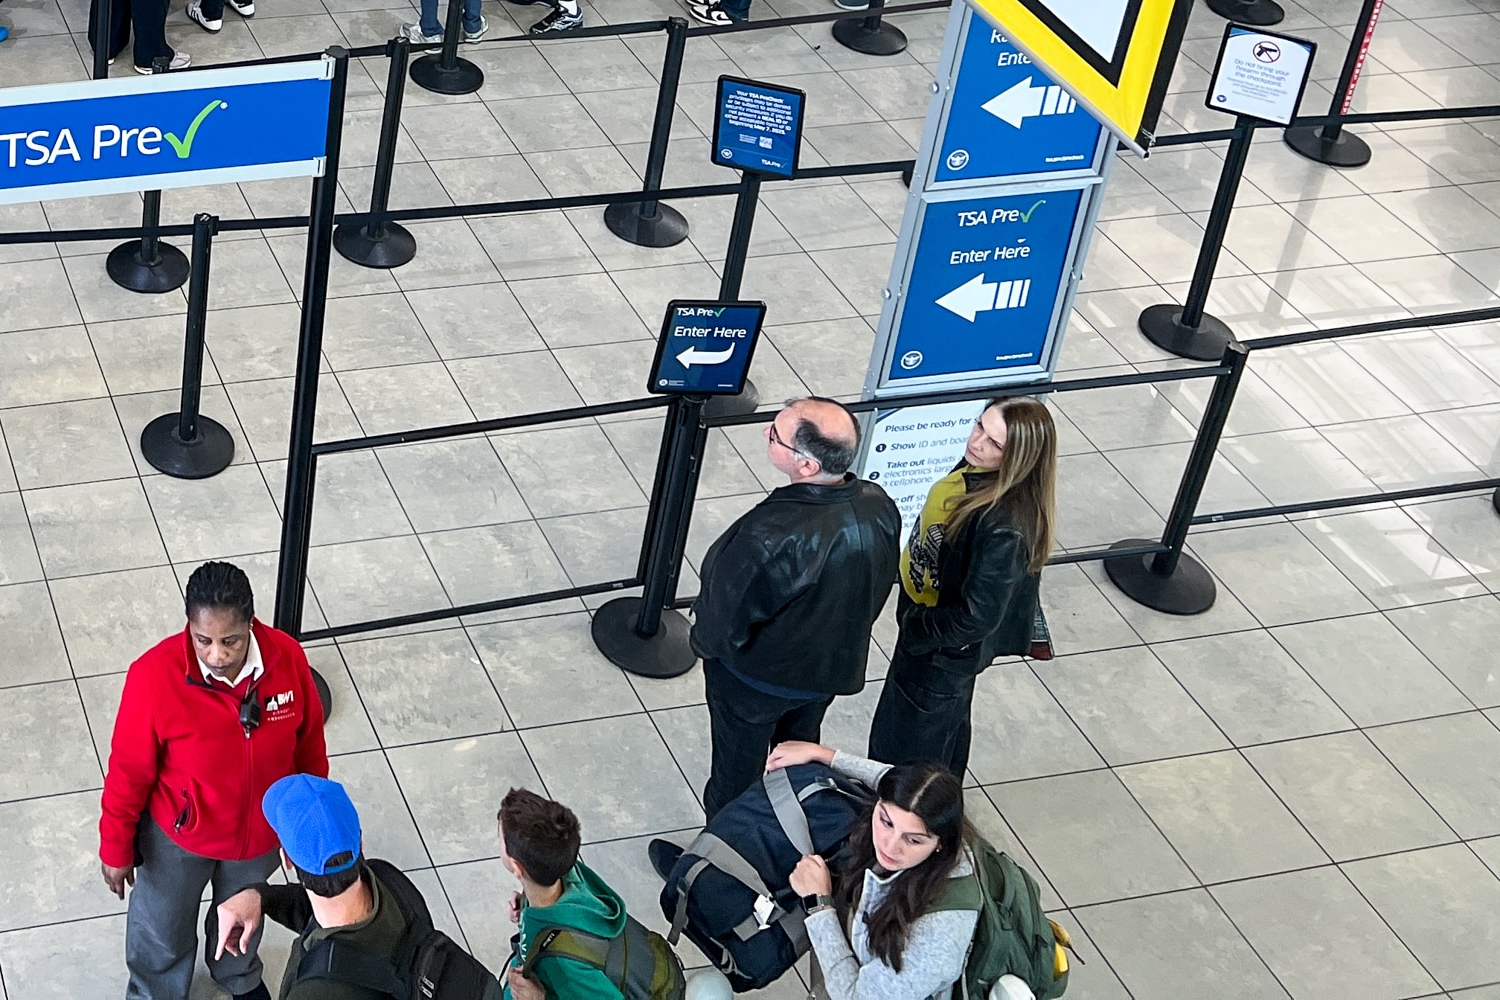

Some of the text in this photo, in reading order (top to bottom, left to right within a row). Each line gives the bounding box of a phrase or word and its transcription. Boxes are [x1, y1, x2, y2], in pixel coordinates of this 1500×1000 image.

[997, 52, 1032, 66] Ente
[1236, 65, 1286, 82] firearm through
[1257, 63, 1274, 73] bring
[760, 94, 784, 104] PreCheck
[0, 124, 162, 168] TSA Pre
[957, 208, 1020, 227] TSA Pre
[950, 245, 1030, 265] Enter Here
[677, 308, 714, 317] TSA Pre
[674, 326, 746, 338] Enter Here
[885, 424, 915, 433] Please
[916, 422, 928, 430] be
[930, 418, 957, 429] ready
[958, 417, 972, 425] for
[890, 443, 916, 451] Show
[918, 440, 929, 449] ID
[887, 456, 956, 469] Take out liquids
[884, 468, 932, 479] electronics
[934, 465, 953, 475] larg
[889, 476, 933, 487] cellphone.
[900, 494, 914, 502] off
[277, 690, 294, 705] BWI
